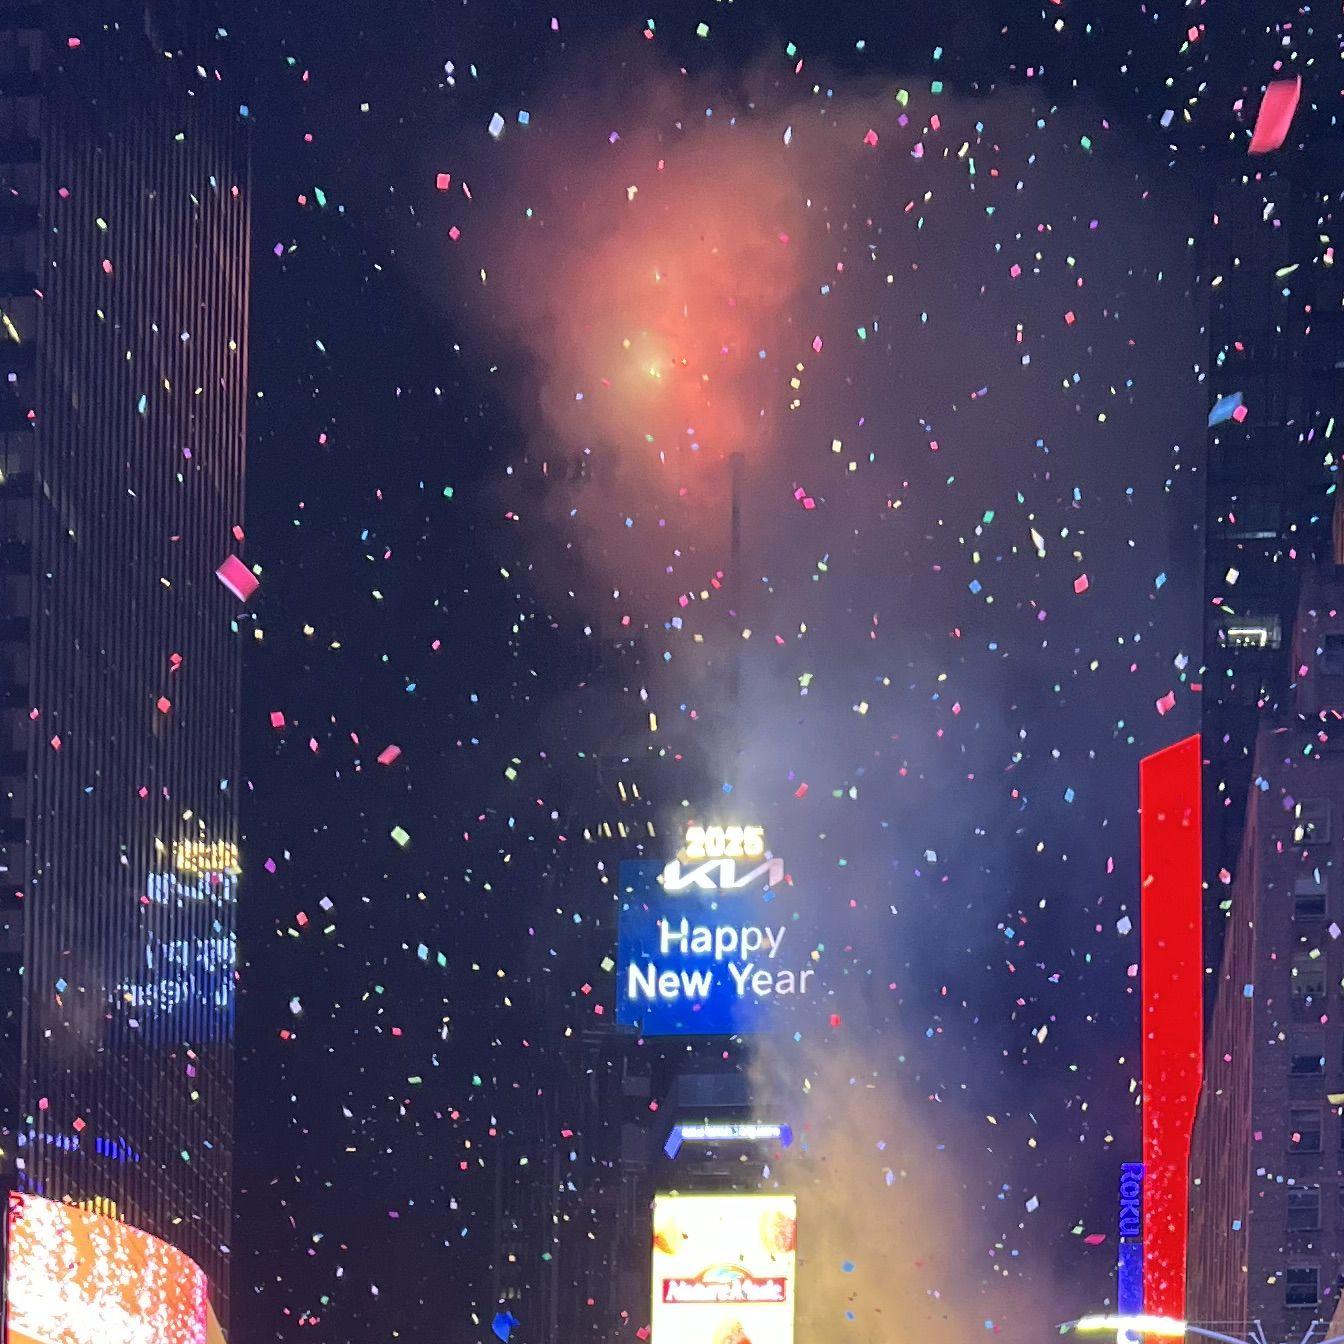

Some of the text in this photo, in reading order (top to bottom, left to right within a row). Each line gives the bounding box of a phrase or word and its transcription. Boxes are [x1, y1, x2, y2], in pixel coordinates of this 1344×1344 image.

[685, 824, 765, 857] 2025
[660, 918, 786, 960] Happy
[627, 962, 814, 999] New Year
[1119, 1163, 1145, 1237] ROKU
